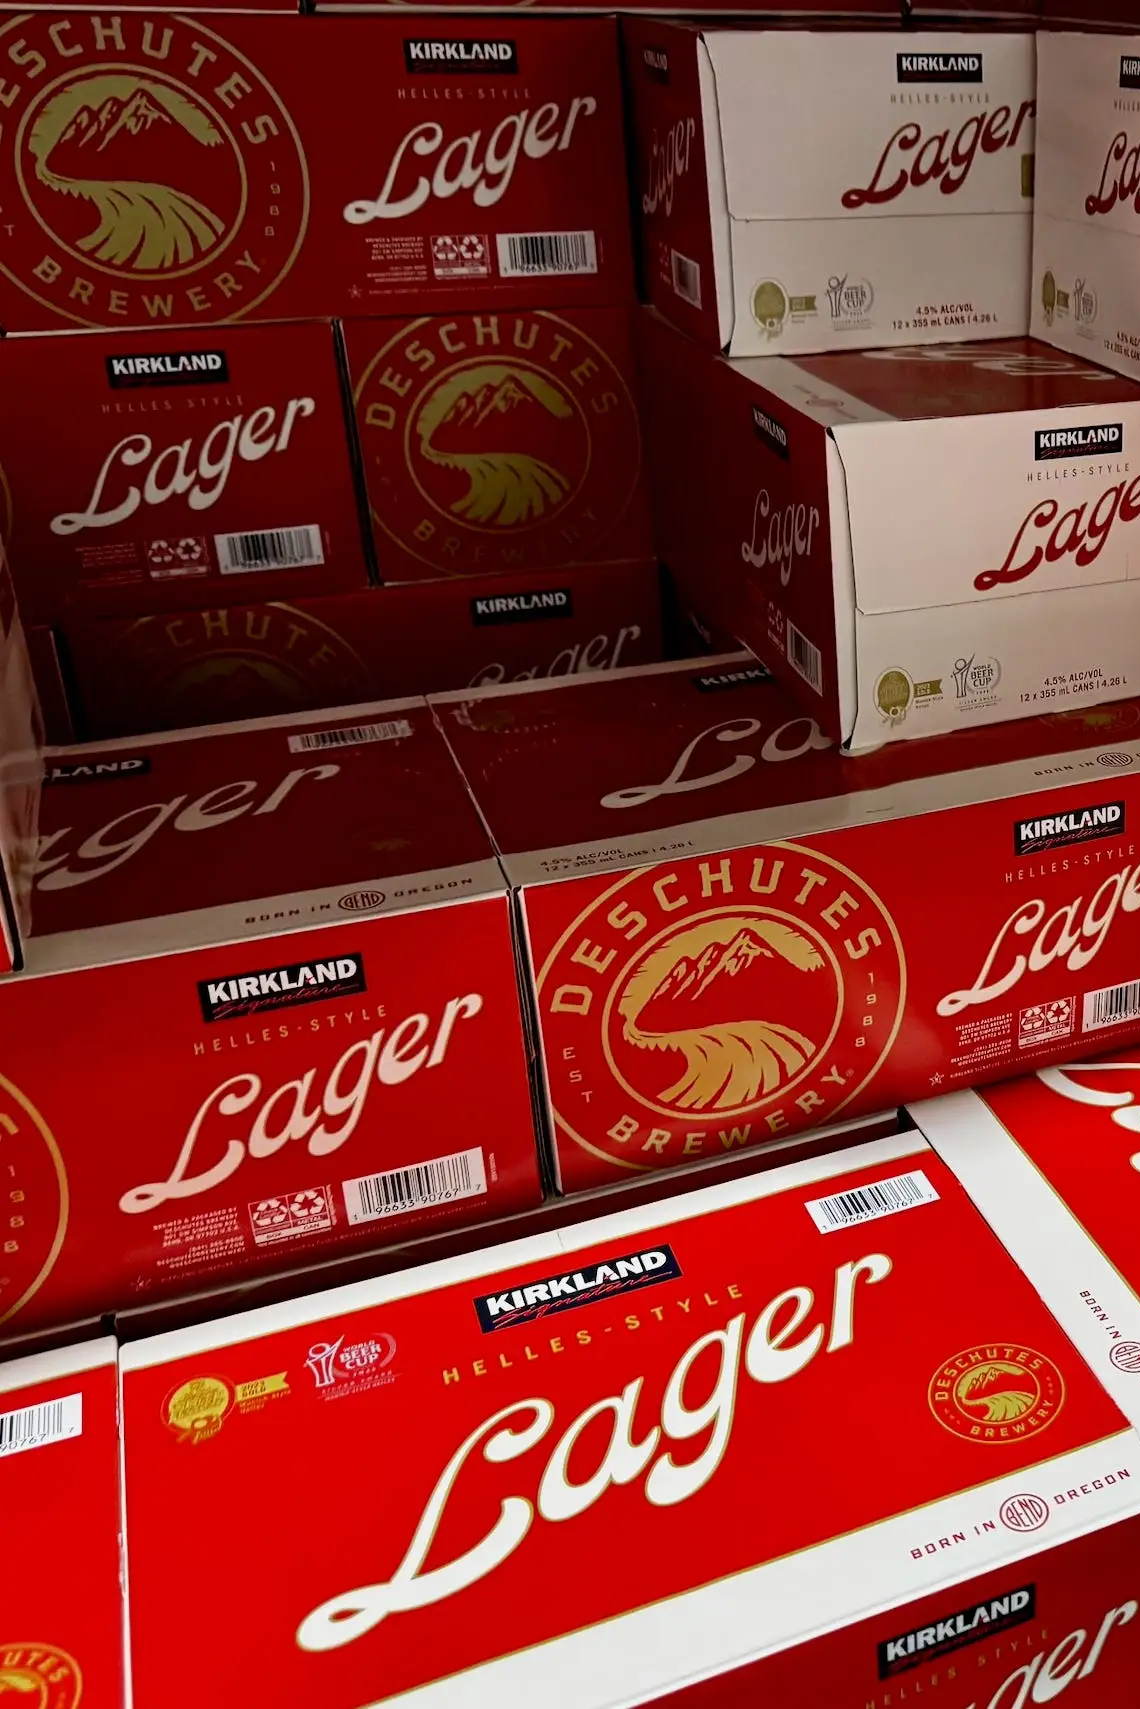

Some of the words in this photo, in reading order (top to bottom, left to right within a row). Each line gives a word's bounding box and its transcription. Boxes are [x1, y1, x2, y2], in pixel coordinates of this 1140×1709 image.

[409, 42, 512, 60] KIRKLAND
[902, 56, 979, 71] KIRKLAND
[343, 96, 596, 225] Lager
[841, 99, 1036, 209] Lager
[31, 250, 262, 318] BREWERY
[111, 353, 223, 376] KIRKLAND
[365, 315, 619, 431] DESCHUTES
[1039, 428, 1119, 448] KIRKLAND
[49, 396, 316, 536] Lager
[1027, 463, 1130, 483] HELLES-STYLE
[741, 488, 820, 587] Lager
[475, 592, 568, 615] KIRKLAND
[1020, 694, 1029, 703] 12
[1040, 688, 1056, 699] 355
[1059, 685, 1070, 695] mL
[1072, 681, 1094, 693] CANS
[1102, 677, 1120, 688] 4.26
[1044, 675, 1066, 687] 4.5%
[1069, 668, 1103, 683] ALC/VOL
[1020, 806, 1121, 842] KIRKLAND
[1004, 844, 1138, 884] HELLES-STYLE
[550, 856, 884, 1016] DESCHUTES
[206, 959, 358, 1005] KIRKLAND
[193, 1005, 388, 1056] HELLES-STYLE
[1101, 1012, 1128, 1024] 96633
[119, 992, 484, 1214] Lager
[606, 1066, 847, 1157] BREWERY
[375, 1200, 416, 1215] 96633
[420, 1188, 459, 1204] 90767
[842, 1210, 877, 1224] 96633
[881, 1199, 913, 1213] 90767
[486, 1249, 668, 1317] KIRKLAND
[443, 1284, 744, 1385] HELLES-STYLE
[1079, 1289, 1108, 1322] BORN
[1107, 1325, 1122, 1340] IN
[339, 1344, 382, 1363] BEER
[345, 1353, 380, 1369] CUP
[935, 1347, 1043, 1401] DESCHUTES
[970, 1398, 1051, 1438] BREWERY
[296, 1252, 894, 1652] Lager
[910, 1532, 966, 1560] BORN
[973, 1519, 996, 1535] IN
[1054, 1468, 1131, 1506] OREGON
[887, 1590, 1029, 1662] KIRKLAND
